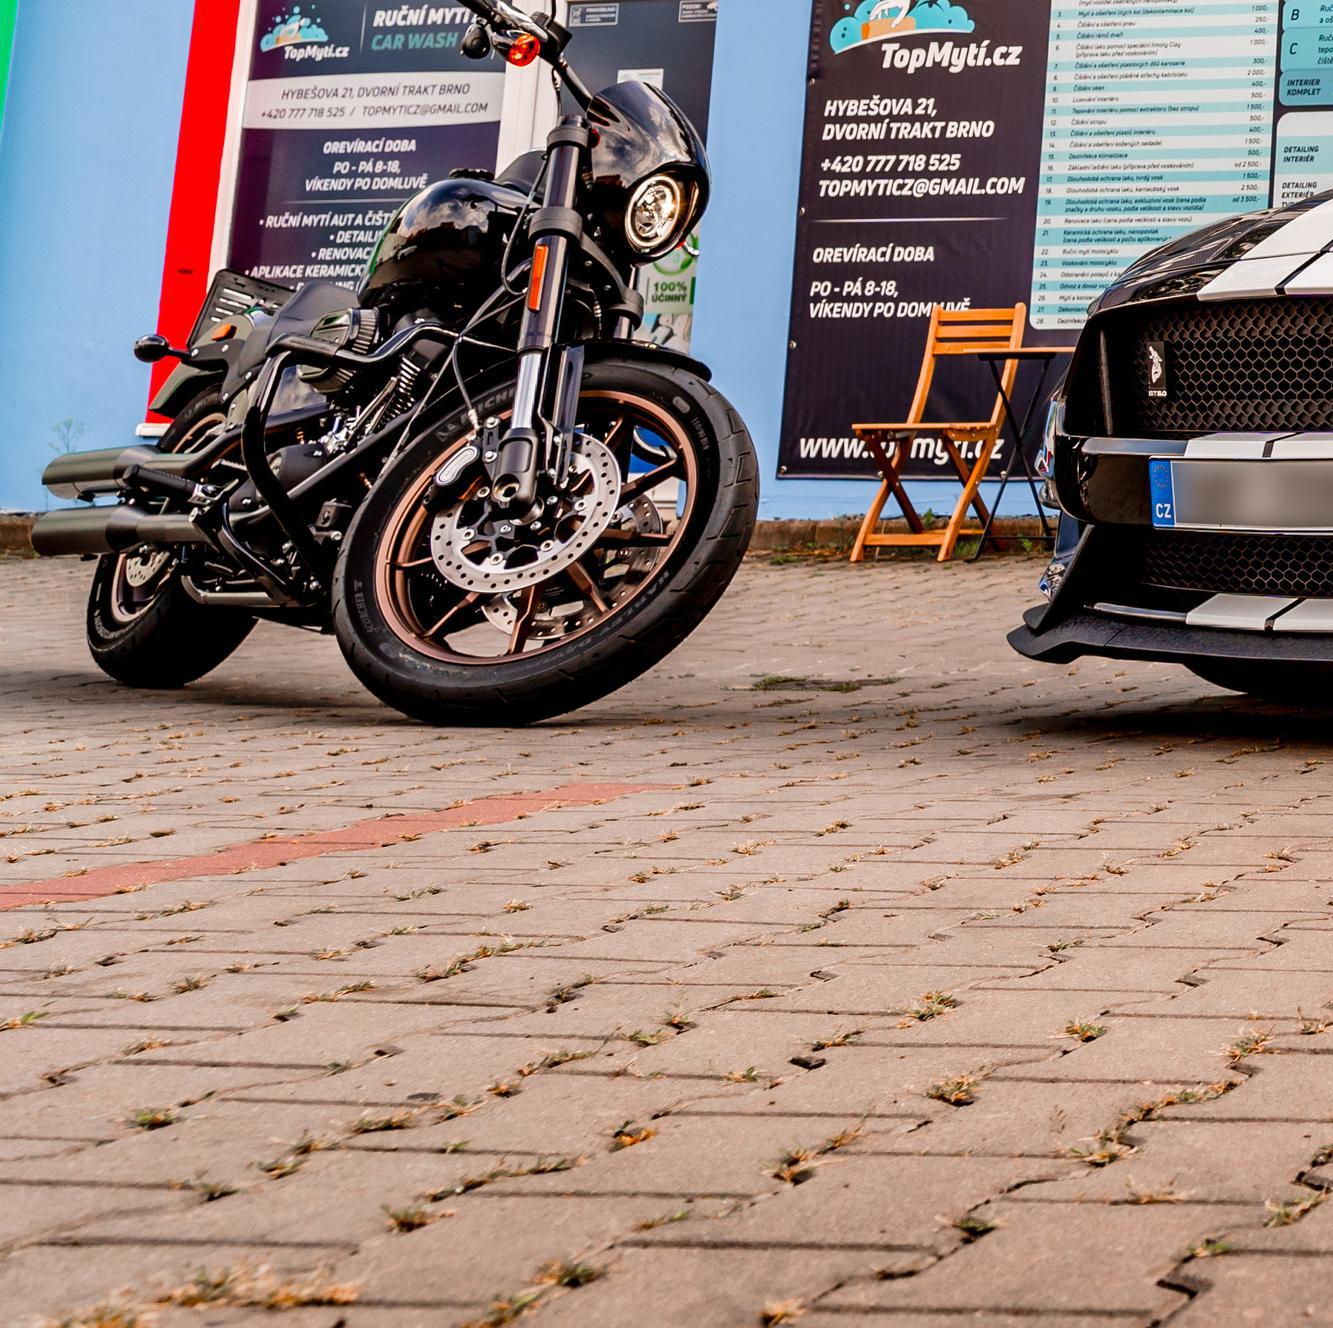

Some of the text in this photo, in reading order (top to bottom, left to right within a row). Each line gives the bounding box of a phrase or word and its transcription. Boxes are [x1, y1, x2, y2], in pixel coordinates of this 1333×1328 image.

[373, 5, 428, 27] RUČNÍ
[1291, 9, 1300, 21] B
[371, 31, 460, 51] CAR WASH
[1289, 42, 1298, 55] C
[284, 43, 350, 62] TopMytí.cz
[881, 39, 1024, 74] TopMytí.cz
[281, 83, 471, 100] HYBEŠOVA 21, DVORNÍ TRAKT BRNO
[1286, 78, 1321, 87] INTERIER
[1286, 88, 1321, 96] KOMPLET
[261, 102, 489, 120] +420 777 718 525 / TOPMYTICZ@GMAIL.COM
[823, 95, 938, 117] HYBEŠOVA 21,
[822, 119, 995, 141] DVORNÍ TRAKT BRNO
[322, 137, 416, 155] OREVÍRACÍ DOBA
[1283, 145, 1319, 154] DETAILING
[332, 161, 351, 175] PO
[357, 157, 374, 174] PÁ
[374, 160, 401, 174] 8-18,
[820, 153, 962, 173] +420 777 718 525
[1283, 154, 1315, 163] INTERIÉR
[305, 173, 429, 192] VÍKENDY PO DOMLUVĚ
[819, 176, 1025, 198] TOPMYTICZ@GMAIL.COM
[265, 212, 303, 228] RUČNÍ
[301, 211, 333, 227] MYTÍ
[329, 213, 356, 226] AUT
[353, 214, 363, 226] A
[318, 247, 373, 260] RENOVAC
[812, 242, 935, 264] OREVÍRACÍ DOBA
[250, 265, 304, 279] APLIKACE
[654, 281, 687, 292] 100%
[809, 280, 832, 297] PO
[842, 276, 863, 297] PÁ
[864, 280, 899, 298] 8-18,
[651, 292, 687, 303] ÚČINNÝ
[809, 299, 873, 319] VÍKENDY
[873, 302, 897, 318] PO
[1155, 503, 1172, 518] CZ
